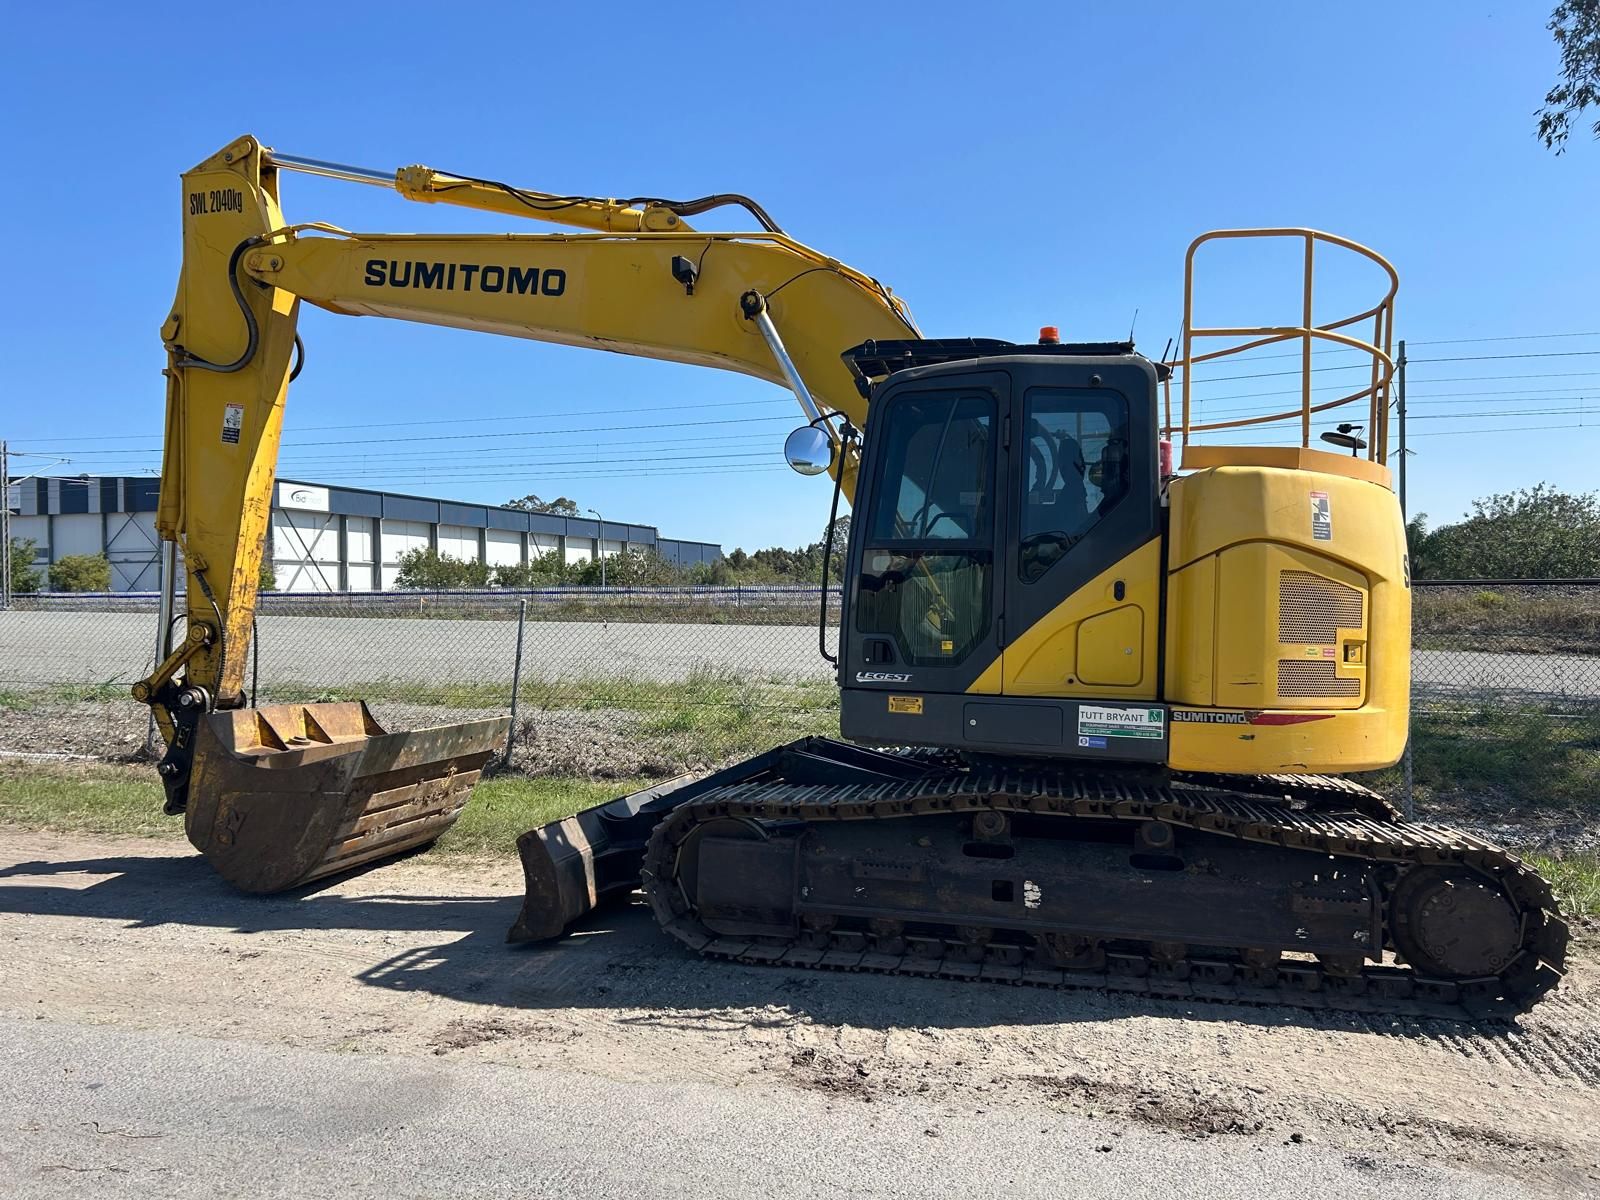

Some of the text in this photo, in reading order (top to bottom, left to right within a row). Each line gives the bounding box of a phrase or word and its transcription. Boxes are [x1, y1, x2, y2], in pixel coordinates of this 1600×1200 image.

[190, 188, 243, 215] SWL 2040kg
[364, 259, 567, 297] SUMITOMO
[856, 671, 913, 682] LEGEST
[1080, 711, 1145, 722] TUTT BRYANT
